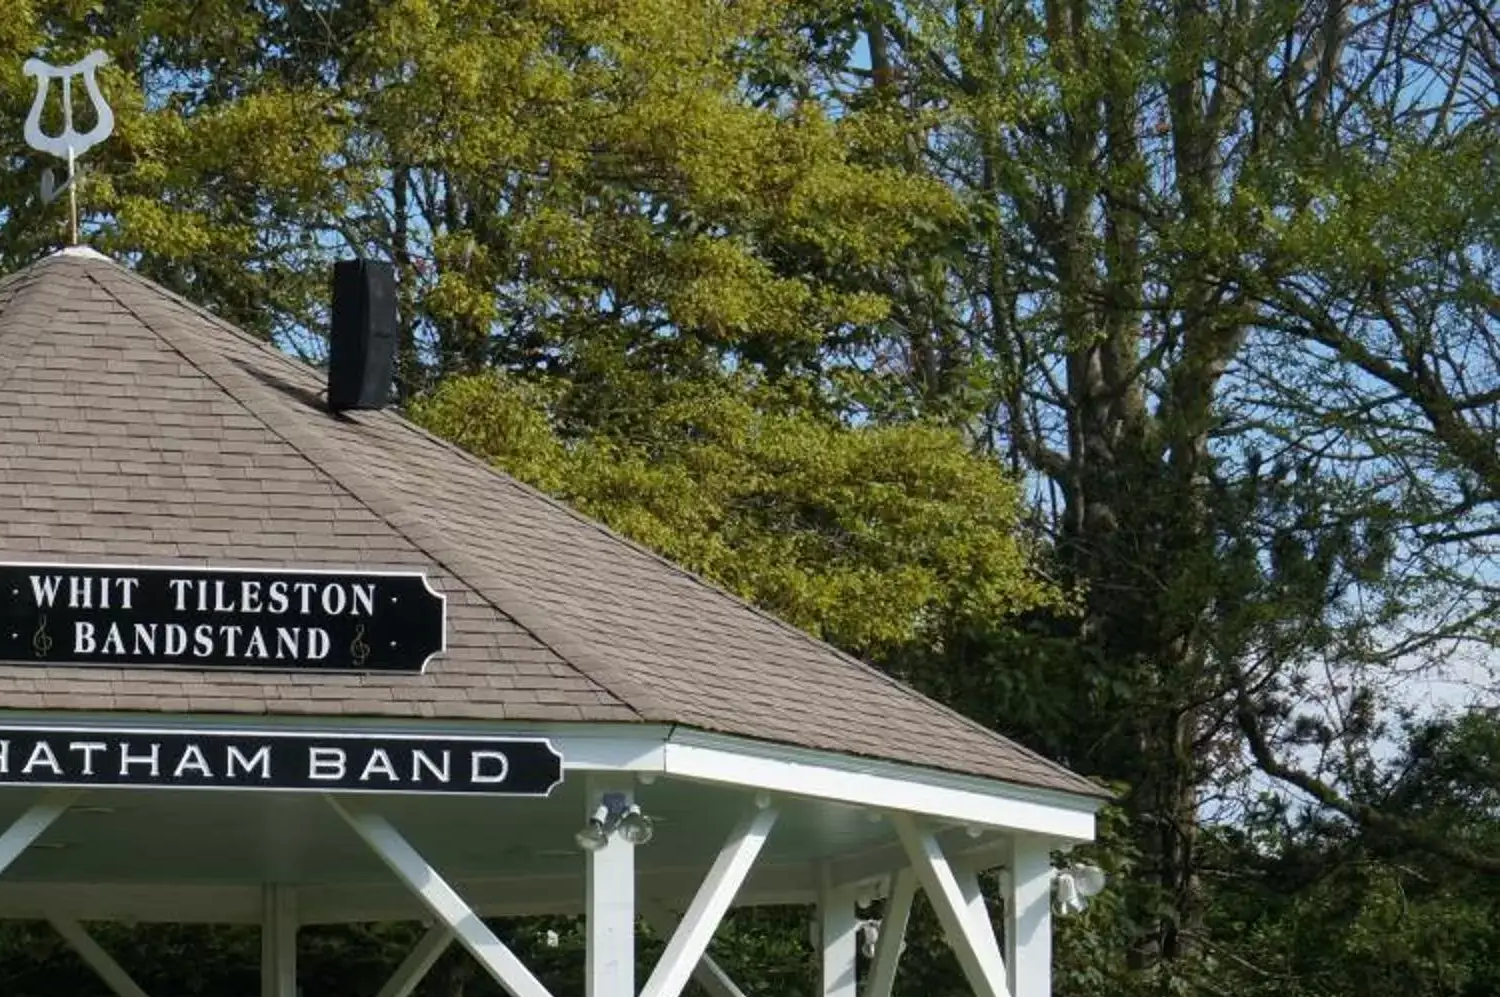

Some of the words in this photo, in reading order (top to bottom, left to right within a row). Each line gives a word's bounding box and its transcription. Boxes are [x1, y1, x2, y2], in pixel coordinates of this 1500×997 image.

[28, 575, 139, 610] WHIT
[169, 578, 377, 617] TILESTON
[72, 621, 332, 660] BANDSTAND
[307, 746, 510, 784] BAND
